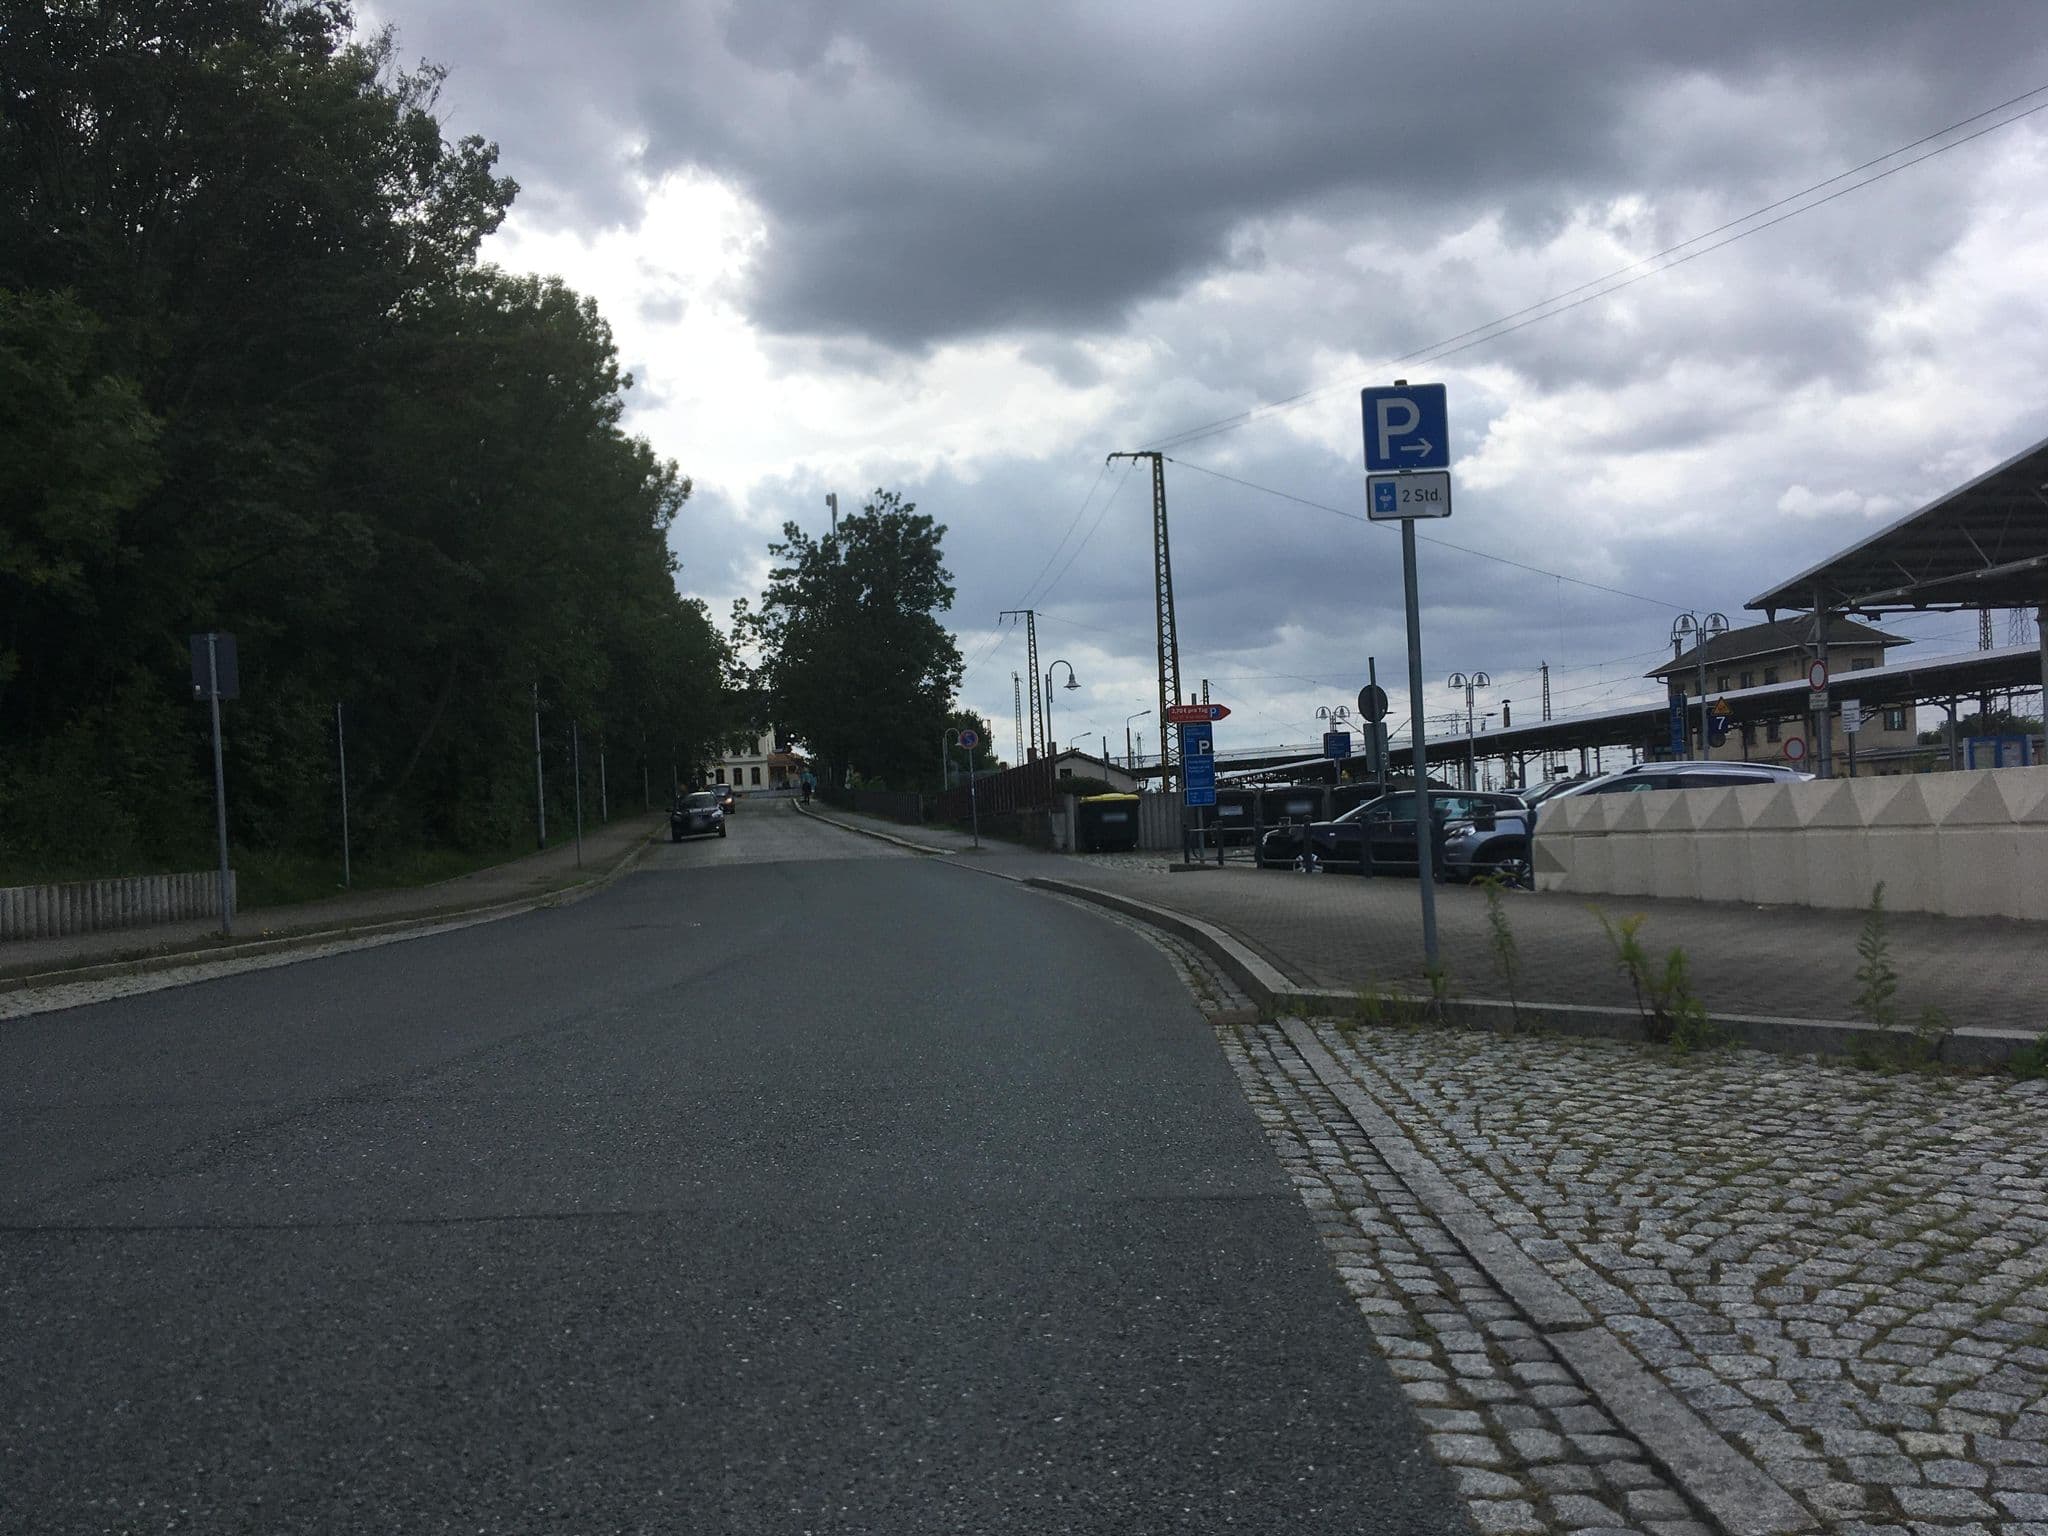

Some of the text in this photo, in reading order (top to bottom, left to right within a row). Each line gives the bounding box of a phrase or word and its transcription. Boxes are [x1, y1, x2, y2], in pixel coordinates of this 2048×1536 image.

[1376, 397, 1421, 460] P
[1402, 487, 1442, 503] 2 Std.
[1210, 708, 1217, 718] P
[1716, 716, 1726, 730] 7
[1198, 740, 1210, 755] P
